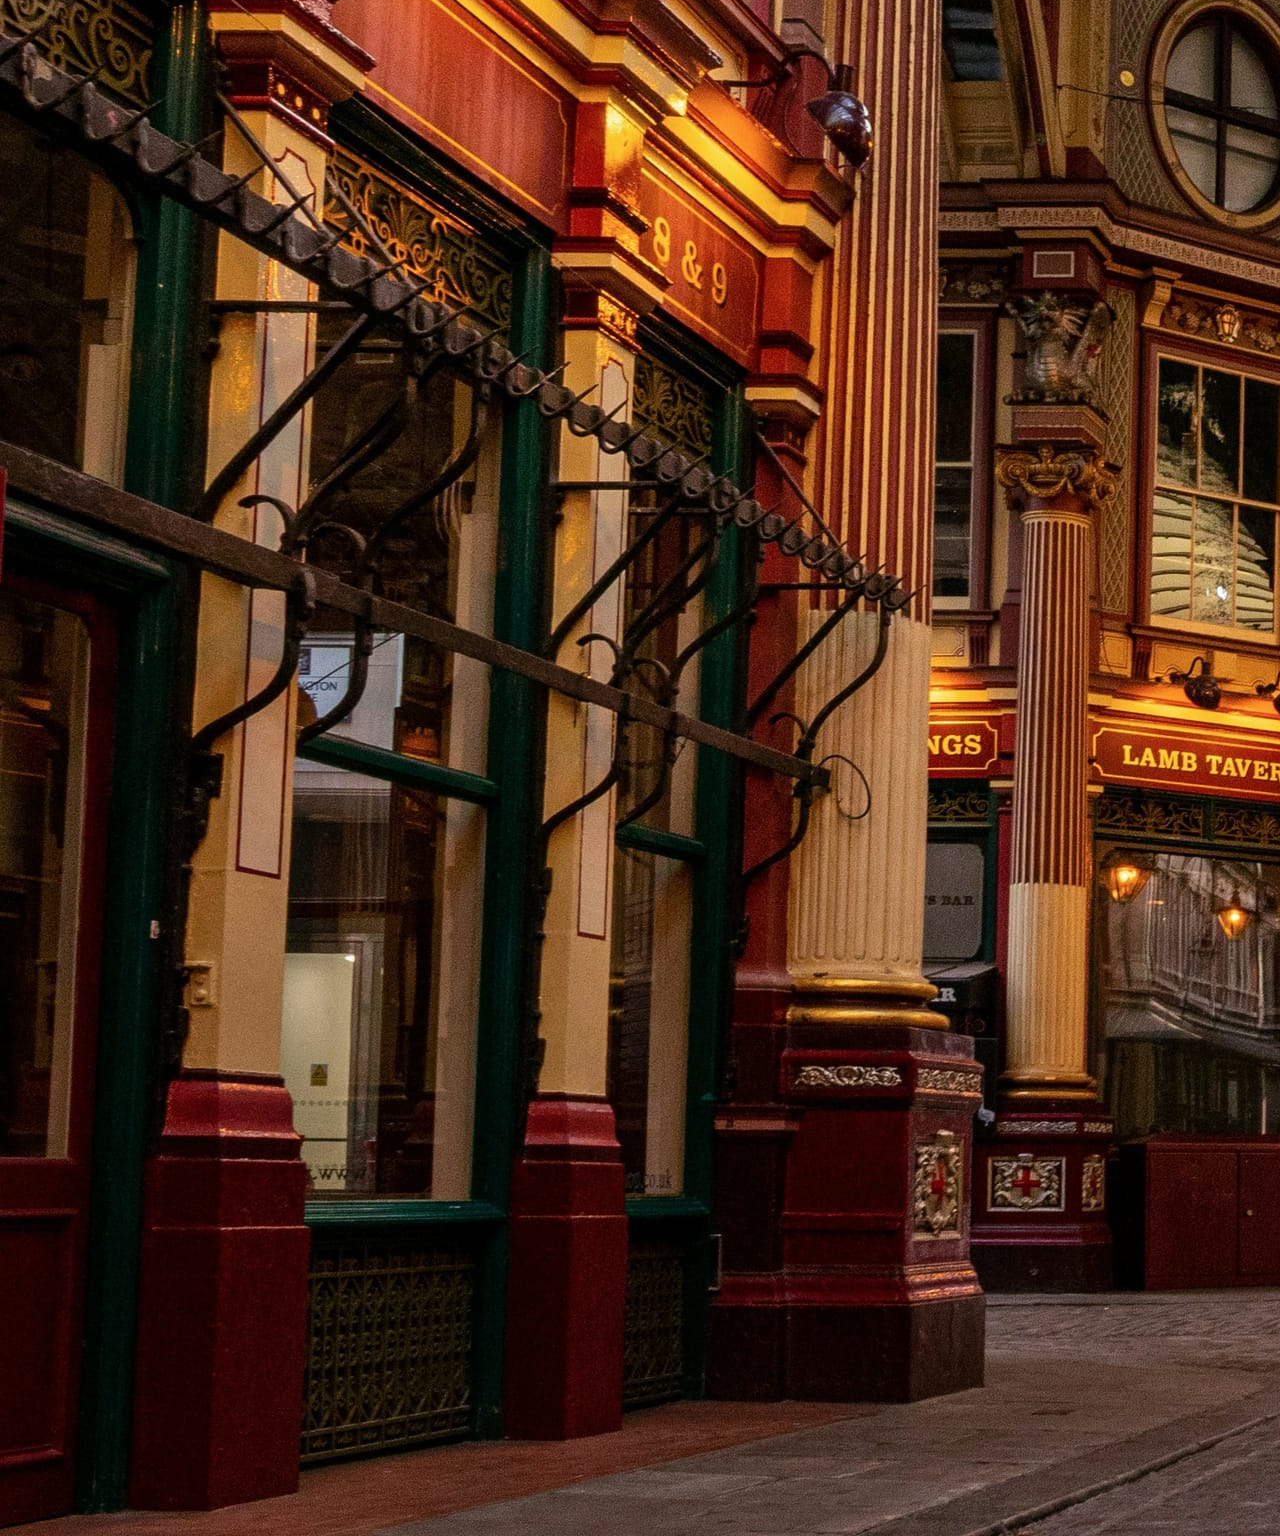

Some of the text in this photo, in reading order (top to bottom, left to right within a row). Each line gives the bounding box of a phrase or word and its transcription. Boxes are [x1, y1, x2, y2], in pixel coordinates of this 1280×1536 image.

[653, 217, 728, 306] 8 & 9
[928, 734, 982, 755] NGS
[1121, 745, 1199, 773] LAMB
[941, 895, 975, 906] BAR
